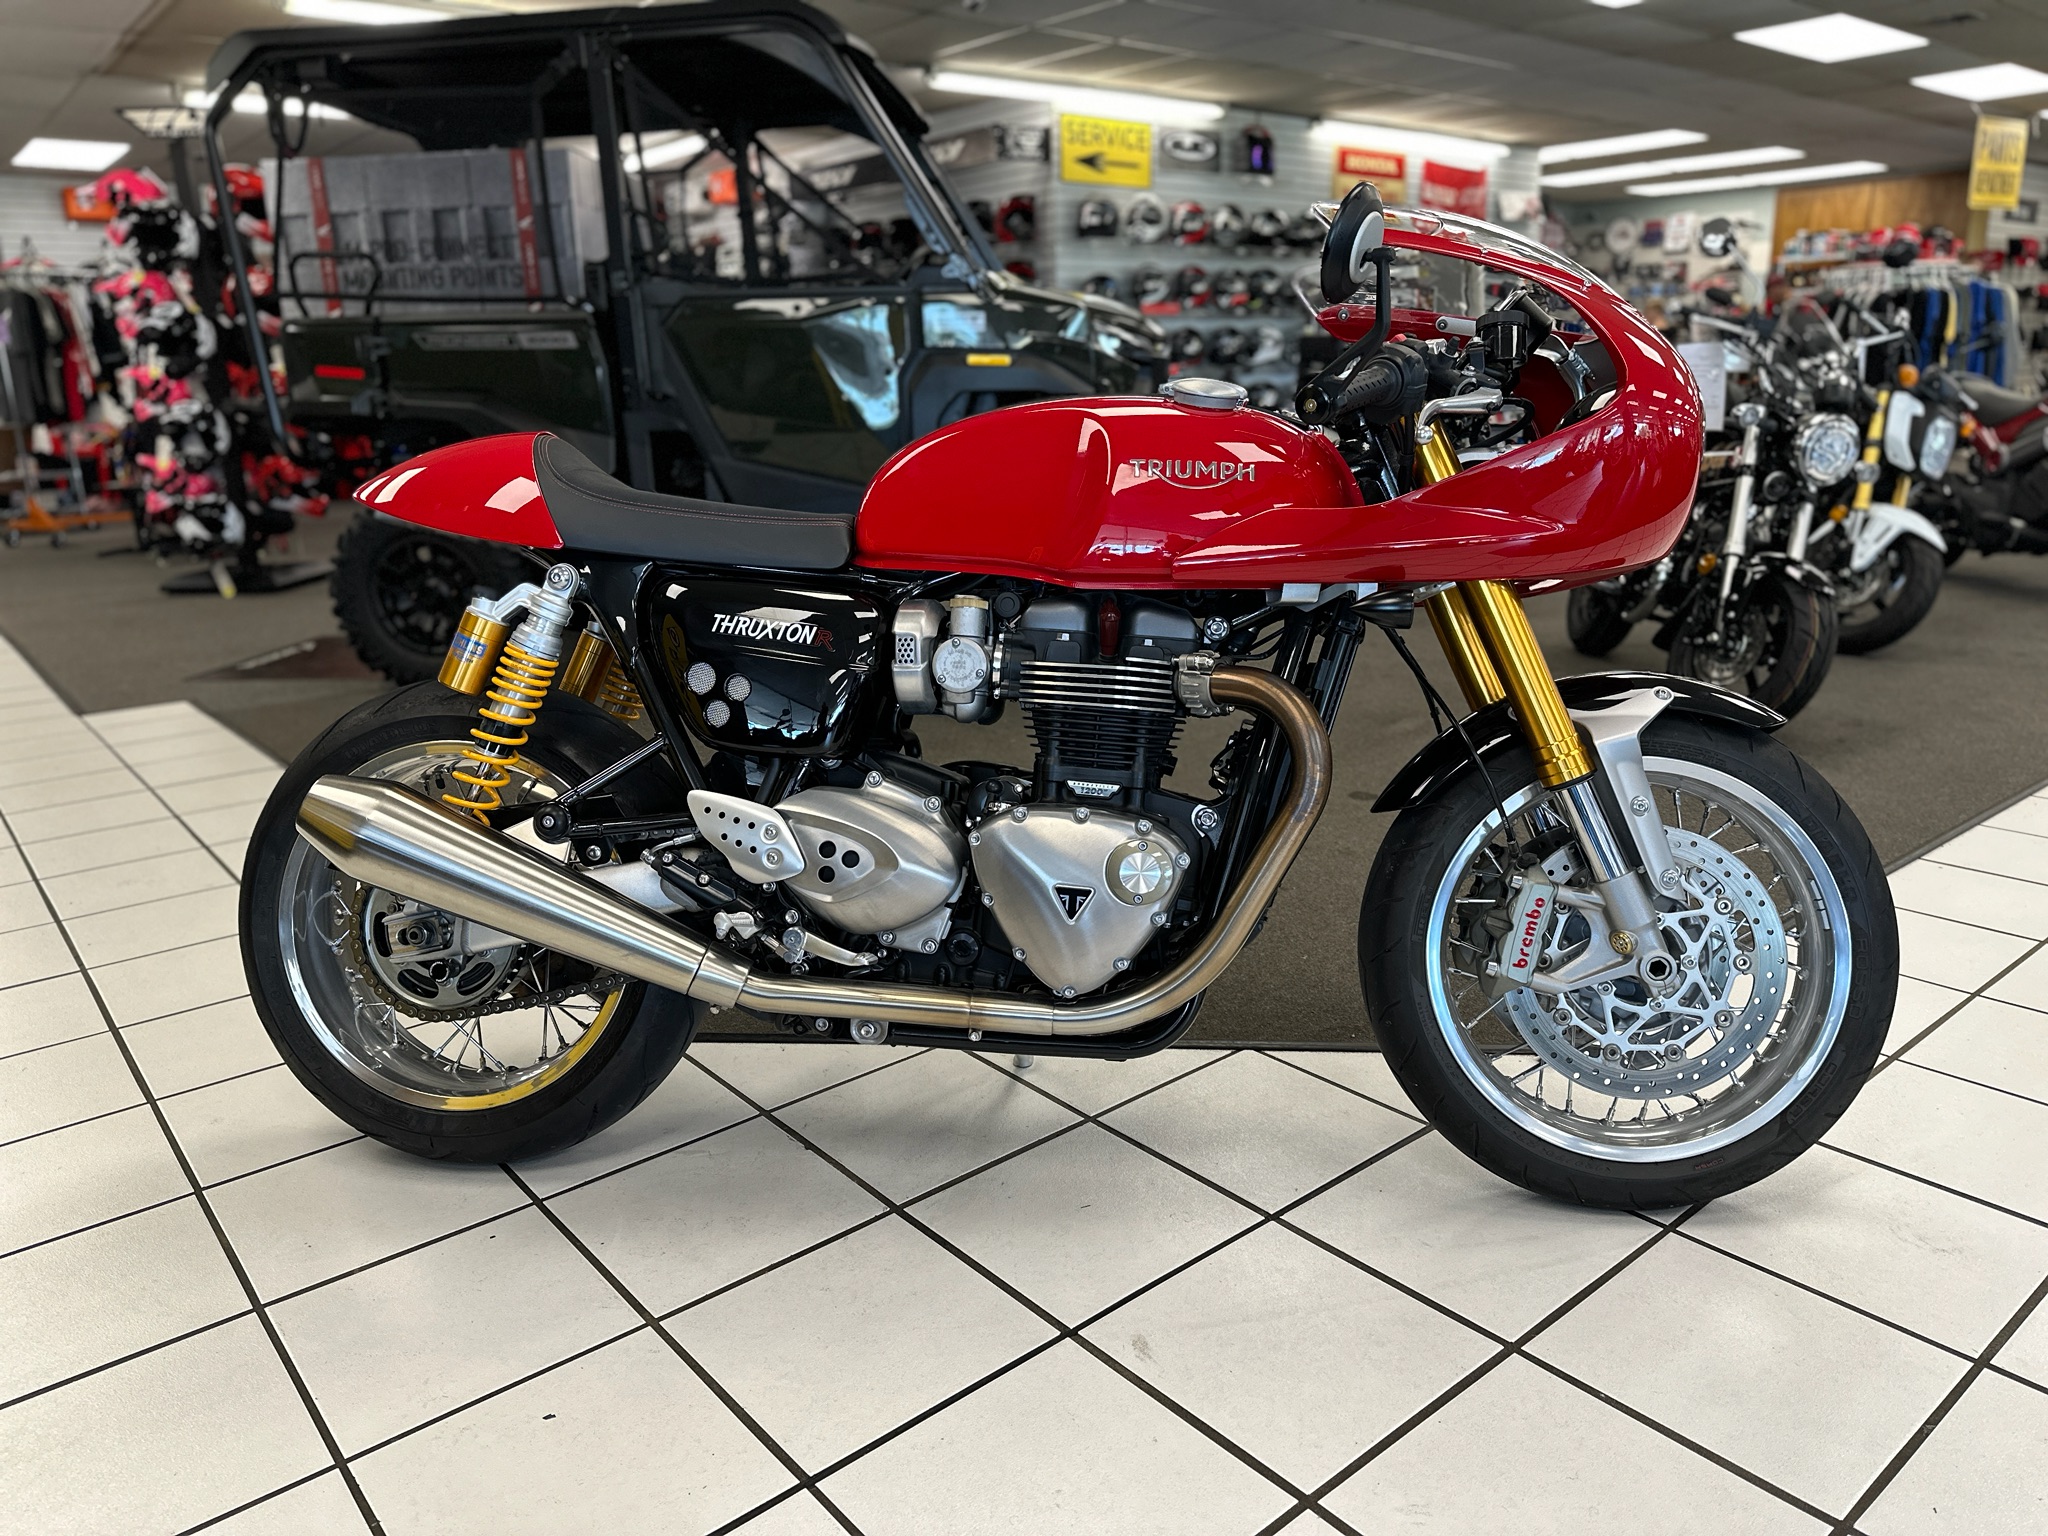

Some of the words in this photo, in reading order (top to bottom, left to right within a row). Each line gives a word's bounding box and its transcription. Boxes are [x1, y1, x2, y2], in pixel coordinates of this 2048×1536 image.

[1065, 118, 1148, 153] SERVICE
[449, 265, 525, 289] POINTS
[1129, 458, 1255, 482] TRIUMPH
[711, 614, 817, 645] THRUXTON
[814, 629, 835, 651] R
[1512, 897, 1546, 969] brembo
[1848, 938, 1870, 1021] ROSSO
[1789, 1062, 1838, 1119] CORSA
